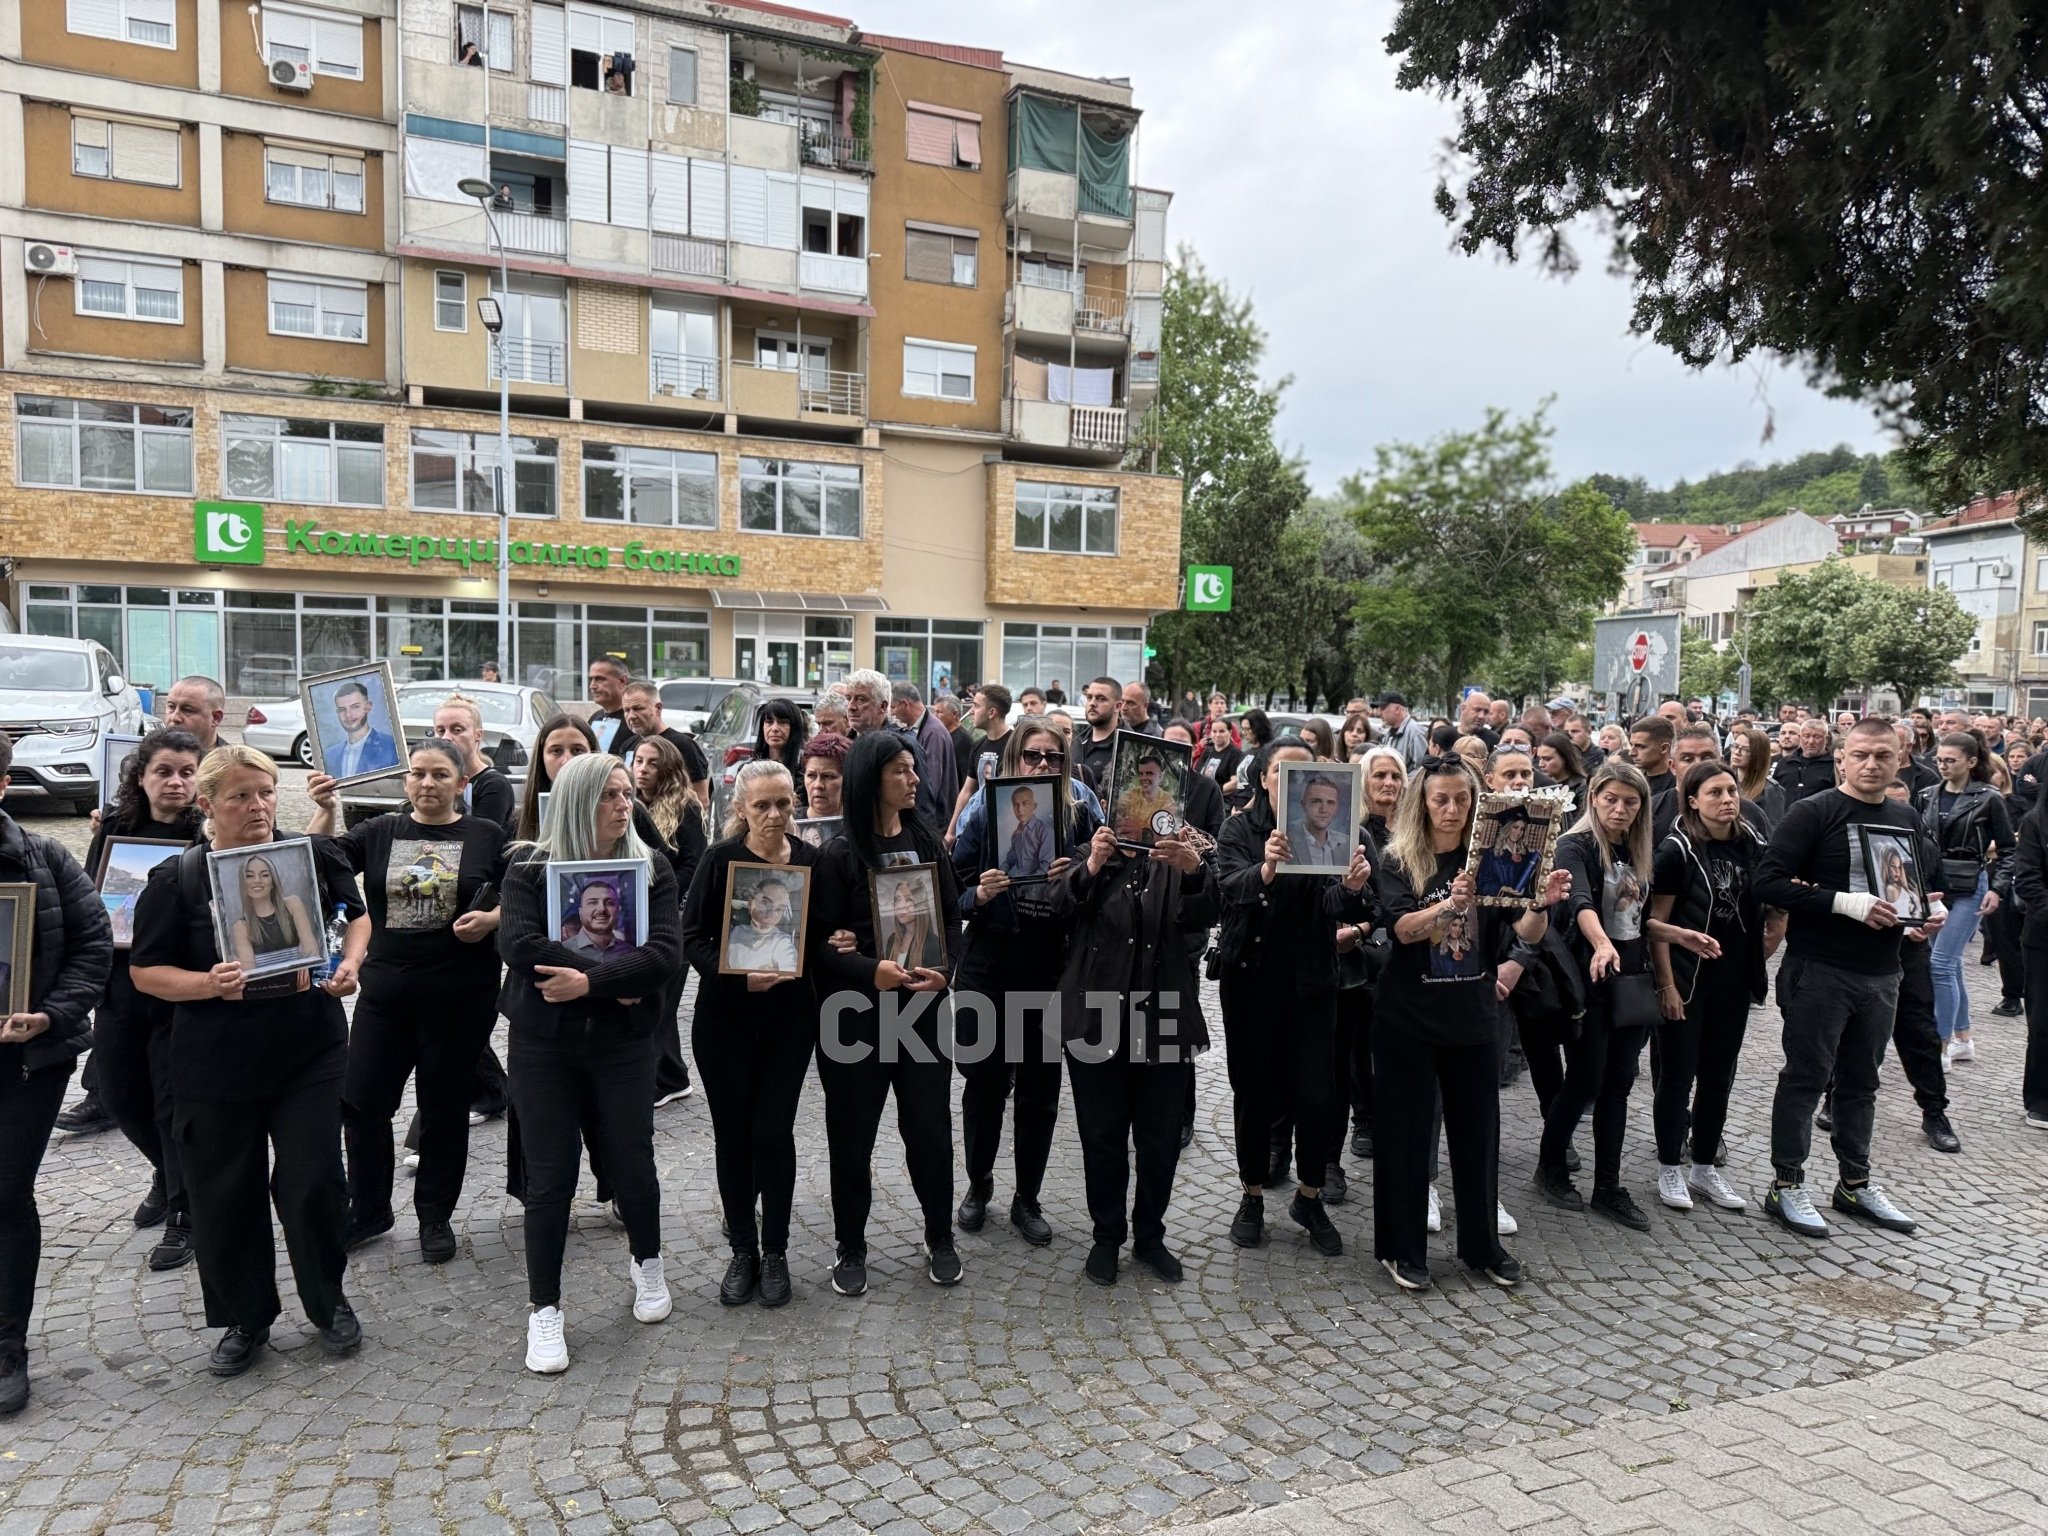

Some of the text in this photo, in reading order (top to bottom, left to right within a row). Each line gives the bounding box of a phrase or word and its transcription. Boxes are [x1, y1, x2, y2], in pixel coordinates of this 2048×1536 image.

[286, 519, 741, 577] Комерциална банка
[1633, 644, 1647, 660] STOP
